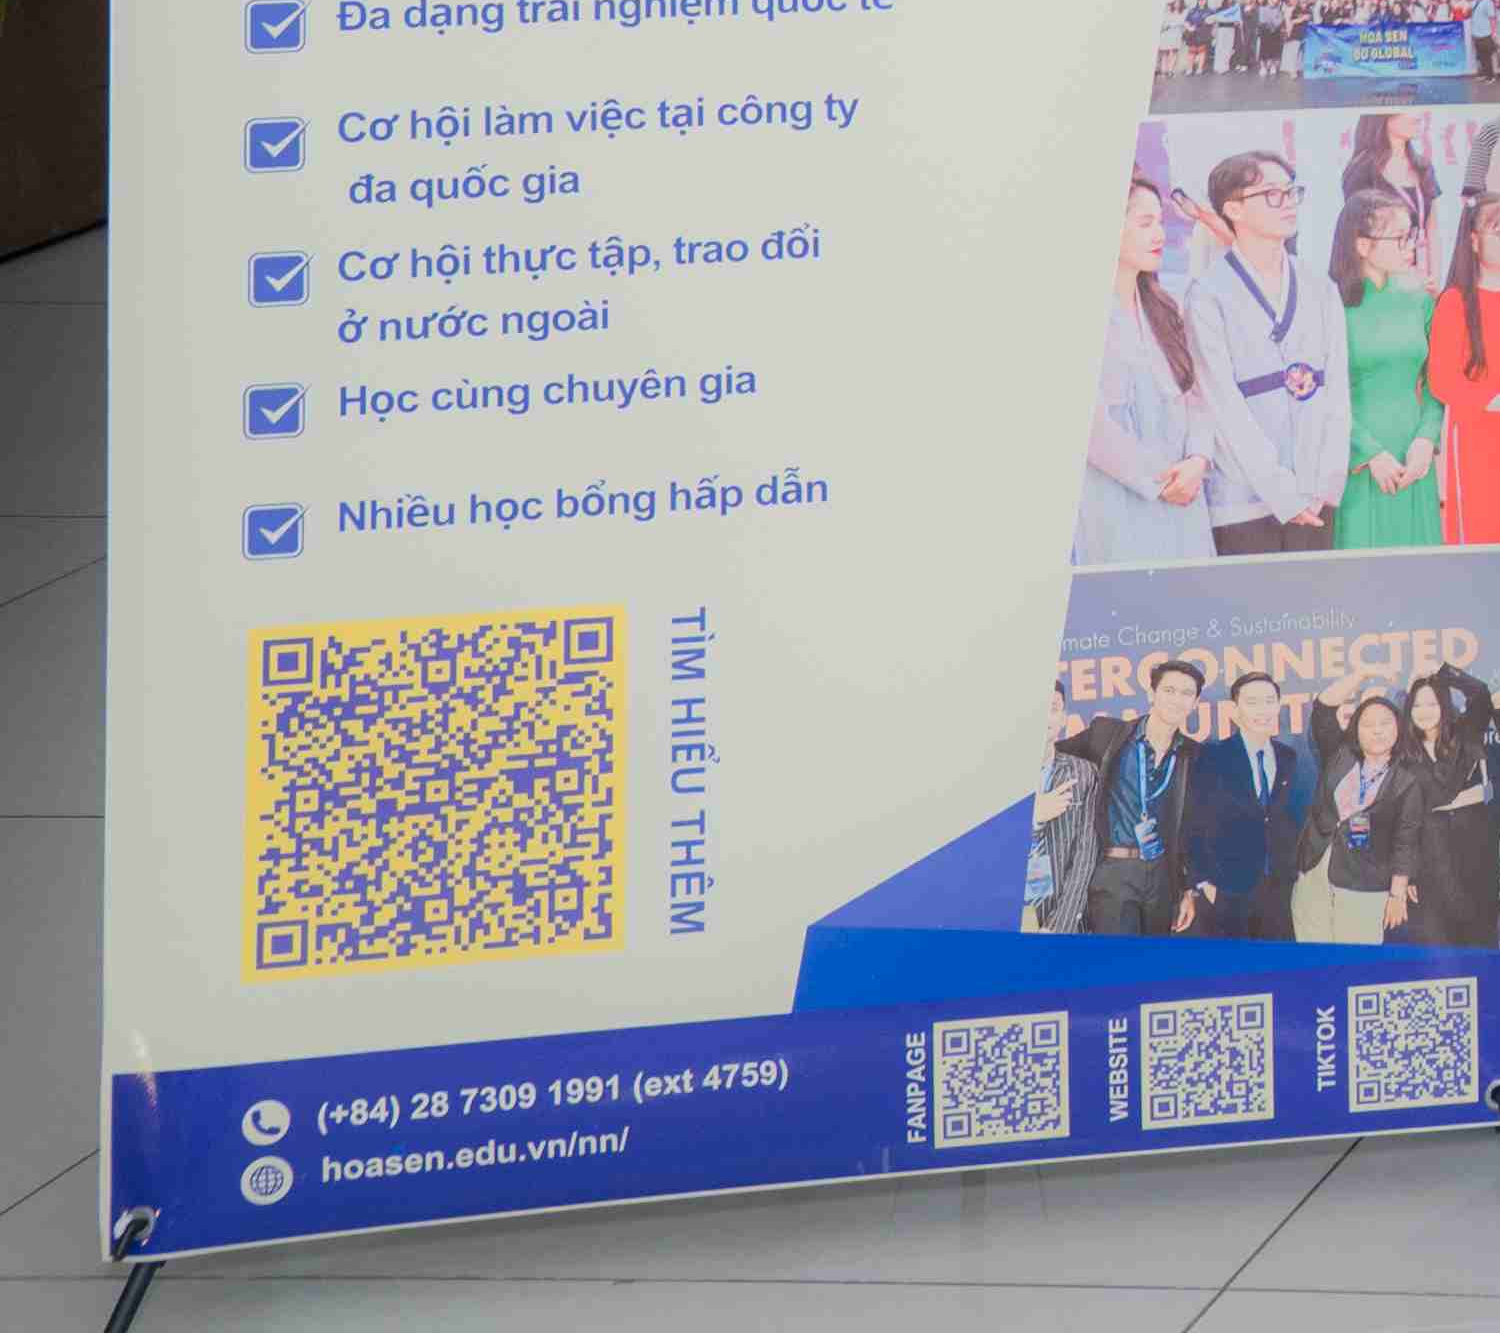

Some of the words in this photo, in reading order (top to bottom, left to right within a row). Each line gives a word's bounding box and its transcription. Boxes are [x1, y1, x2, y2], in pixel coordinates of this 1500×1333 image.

[336, 1, 390, 31] Đa
[339, 112, 400, 142] Cơ
[411, 106, 469, 146] hội
[485, 105, 552, 136] làm
[566, 99, 646, 138] việc
[657, 97, 704, 135] tại
[718, 95, 811, 130] công
[824, 93, 858, 129] ty
[350, 174, 396, 204] đa
[410, 164, 509, 208] quốc
[523, 165, 579, 203] gia
[339, 251, 400, 281] Cơ
[411, 244, 470, 284] hội
[483, 244, 576, 280] thực
[588, 236, 660, 276] tập,
[673, 237, 749, 264] trao
[761, 223, 819, 260] đổi
[338, 309, 368, 343] ở
[380, 306, 488, 341] nước
[502, 300, 608, 341] ngoài
[340, 386, 418, 422] Học
[432, 379, 529, 414] cùng
[544, 369, 686, 409] chuyên
[700, 365, 756, 404] gia
[339, 494, 455, 532] Nhiều
[470, 494, 542, 530] học
[557, 480, 655, 521] bổng
[670, 475, 743, 516] hấp
[756, 467, 827, 505] dẫn
[671, 606, 716, 681] TÌM
[1057, 633, 1111, 652] mate
[1117, 623, 1201, 647] Change
[1207, 618, 1224, 638] &
[1229, 607, 1355, 637] Sustainability
[671, 697, 721, 794] HIỂU
[670, 809, 715, 935] THÊM
[1109, 1018, 1129, 1122] WEBSITE
[1316, 1005, 1337, 1092] TIKTOK
[317, 1096, 401, 1136] (+84)
[410, 1092, 449, 1121] 28
[461, 1083, 537, 1115] 7309
[548, 1076, 620, 1106] 1991
[634, 1068, 693, 1104] (ext
[703, 1058, 789, 1091] 4759)
[906, 1031, 927, 1143] FANPAGE
[322, 1127, 630, 1184] hoasen.edu.vn/nn/
